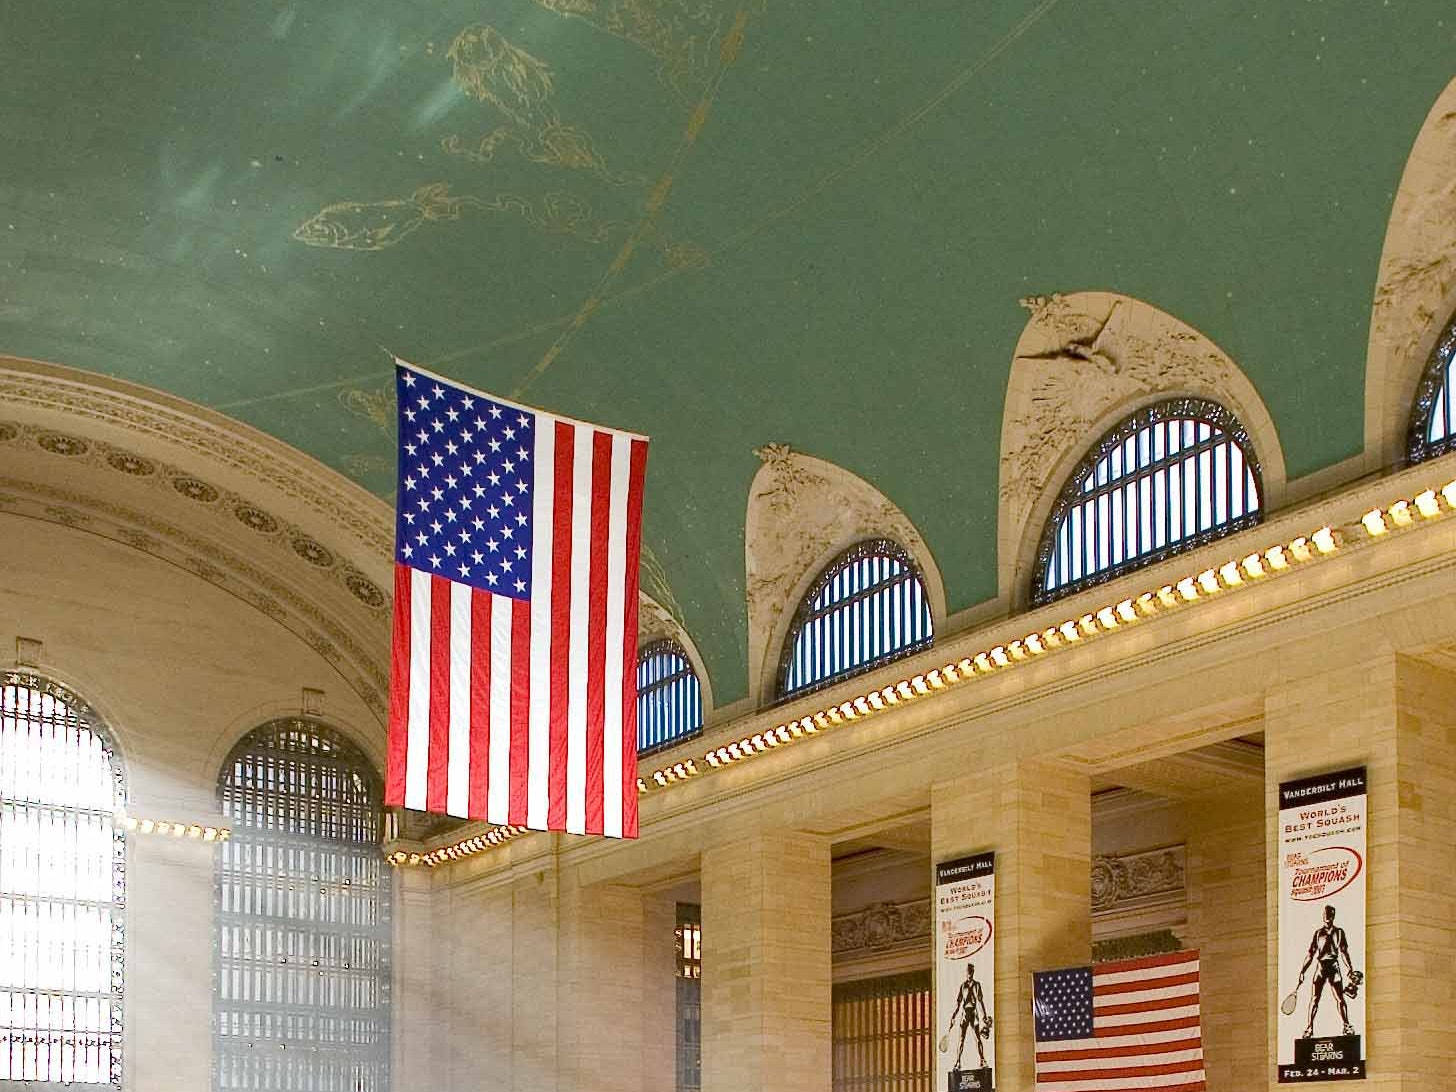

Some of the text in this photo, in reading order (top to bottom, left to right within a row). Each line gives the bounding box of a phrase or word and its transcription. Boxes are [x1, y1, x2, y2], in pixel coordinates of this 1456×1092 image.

[1284, 778, 1364, 800] VANDERBILT HALL
[1300, 804, 1346, 820] WORLD'S
[1285, 814, 1360, 833] BEST SQUASH
[1293, 868, 1347, 888] CHAMPIONS
[1284, 1070, 1304, 1078] FEB.
[1352, 1066, 1360, 1074] 2
